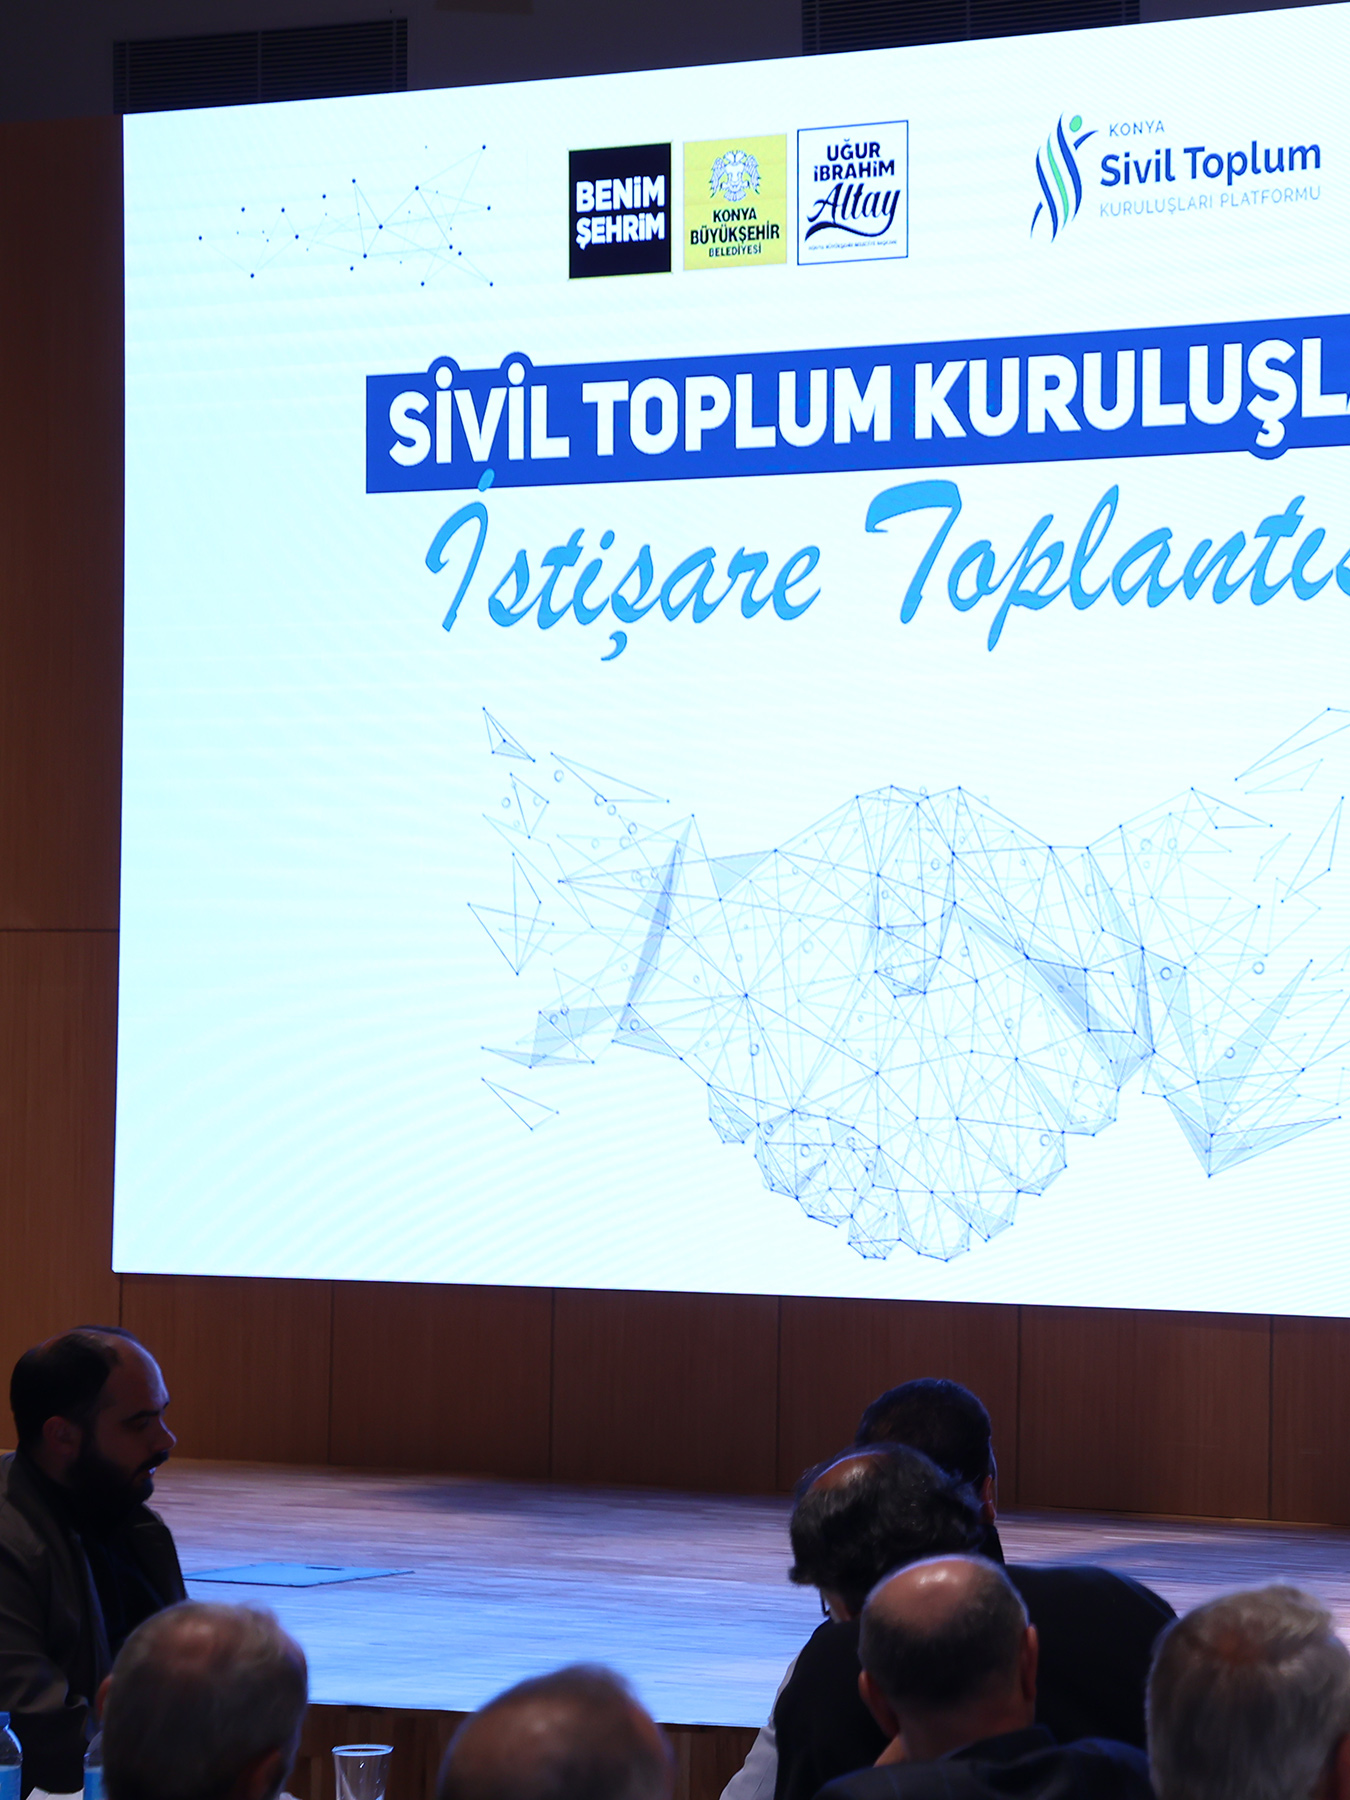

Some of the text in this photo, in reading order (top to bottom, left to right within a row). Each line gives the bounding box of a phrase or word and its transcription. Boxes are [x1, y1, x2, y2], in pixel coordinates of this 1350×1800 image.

[1109, 119, 1165, 137] KONYA
[827, 138, 881, 162] UĞUR
[1100, 140, 1321, 187] Sivil Toplum
[713, 207, 757, 222] KONYA
[804, 182, 901, 243] Altay
[1100, 185, 1321, 217] KURULUŞLARI PLATFORMU
[690, 220, 780, 245] BÜYÜKŞEHİR
[708, 242, 762, 257] BELEDİYESİ
[388, 362, 570, 467] SİVİL
[582, 364, 892, 457] TOPLUM
[425, 468, 822, 662] İstişare
